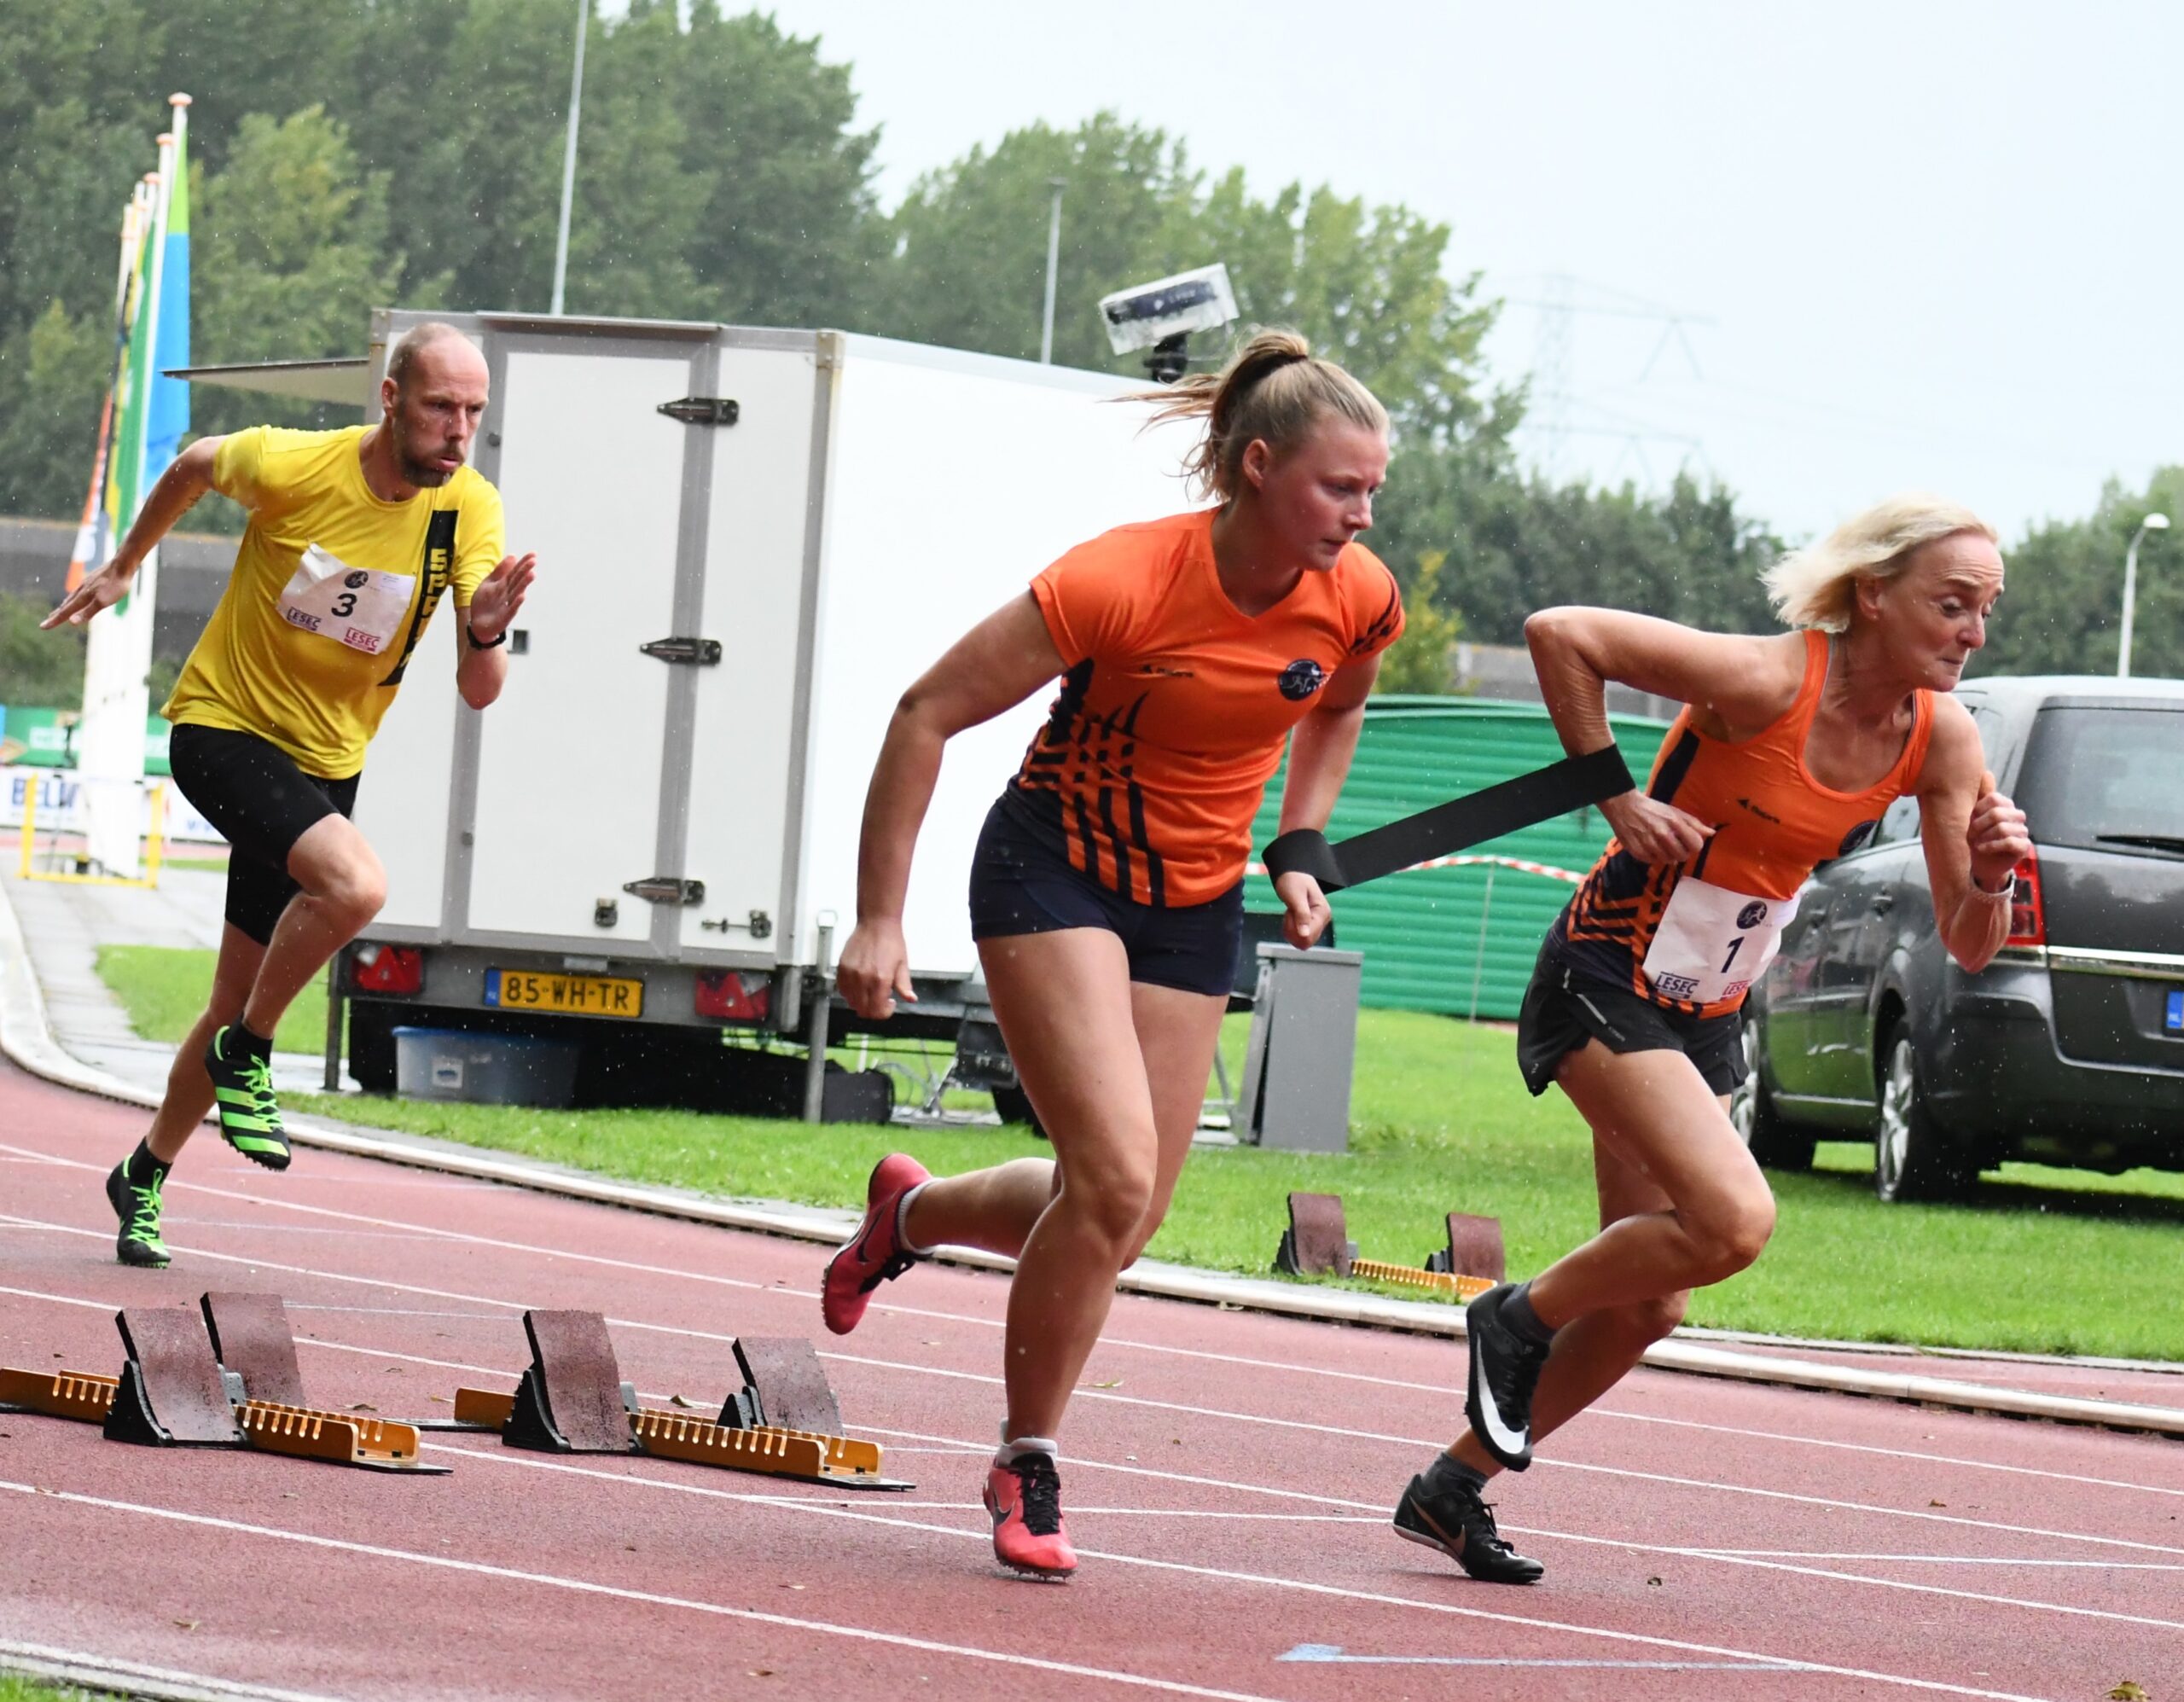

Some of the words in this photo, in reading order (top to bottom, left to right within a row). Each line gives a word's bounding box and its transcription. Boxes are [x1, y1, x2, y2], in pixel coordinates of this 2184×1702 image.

[331, 593, 357, 617] 3
[288, 608, 322, 628] LESEC
[346, 629, 380, 649] LESEC
[1721, 937, 1745, 973] 1
[506, 977, 630, 1010] 85-WH-TR
[1654, 975, 1699, 994] LESEC
